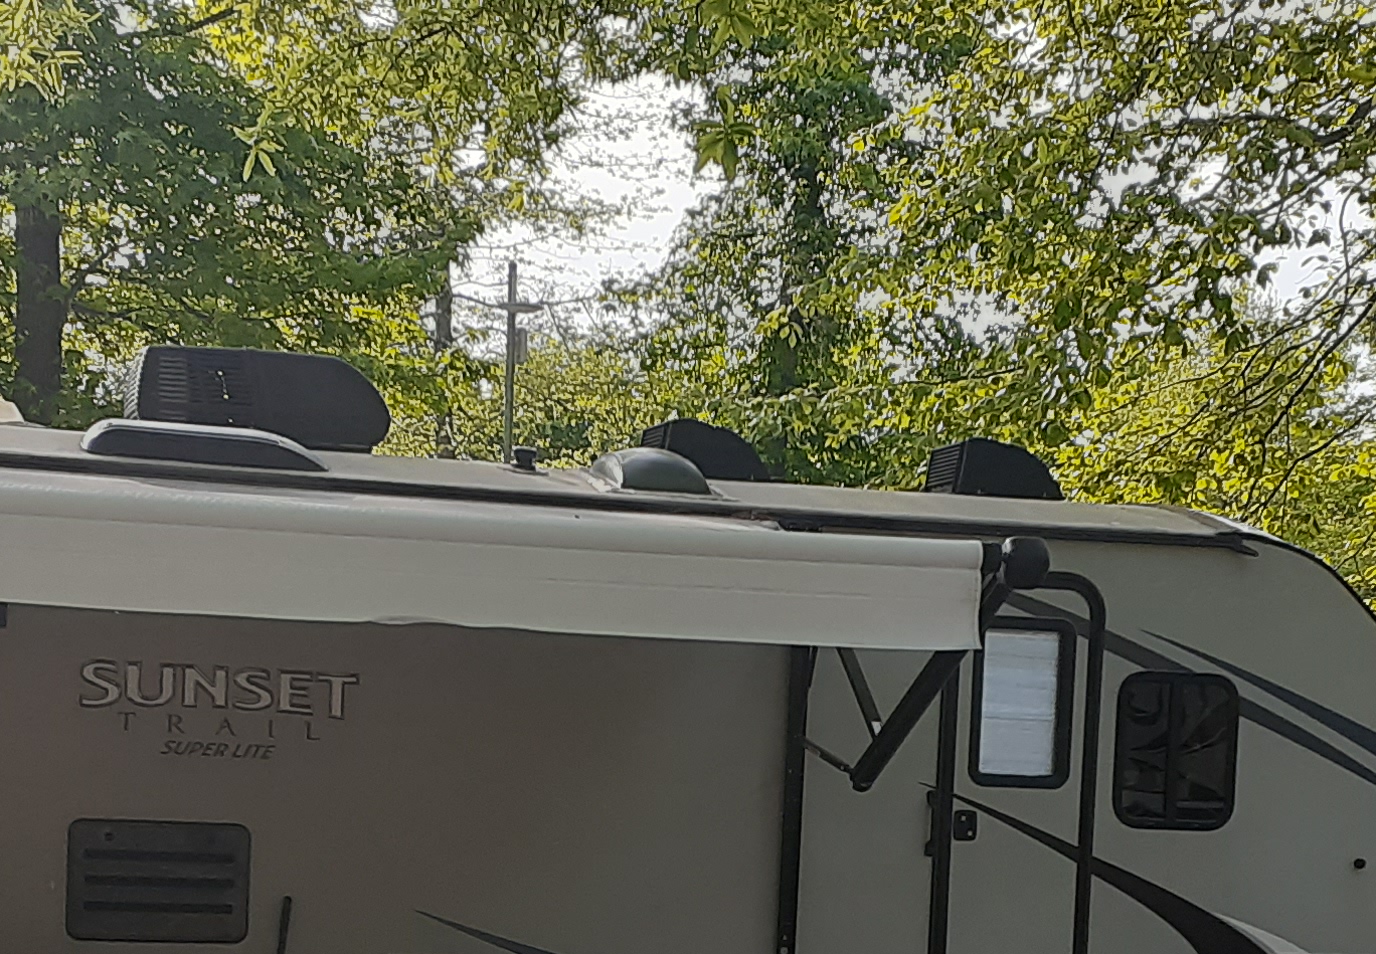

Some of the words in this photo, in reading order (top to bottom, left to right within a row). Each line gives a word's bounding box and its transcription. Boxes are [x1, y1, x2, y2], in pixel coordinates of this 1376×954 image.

[79, 659, 359, 720] SUNSET
[118, 712, 320, 741] TRAIL
[161, 740, 230, 759] SUPER
[231, 743, 275, 760] LITE
